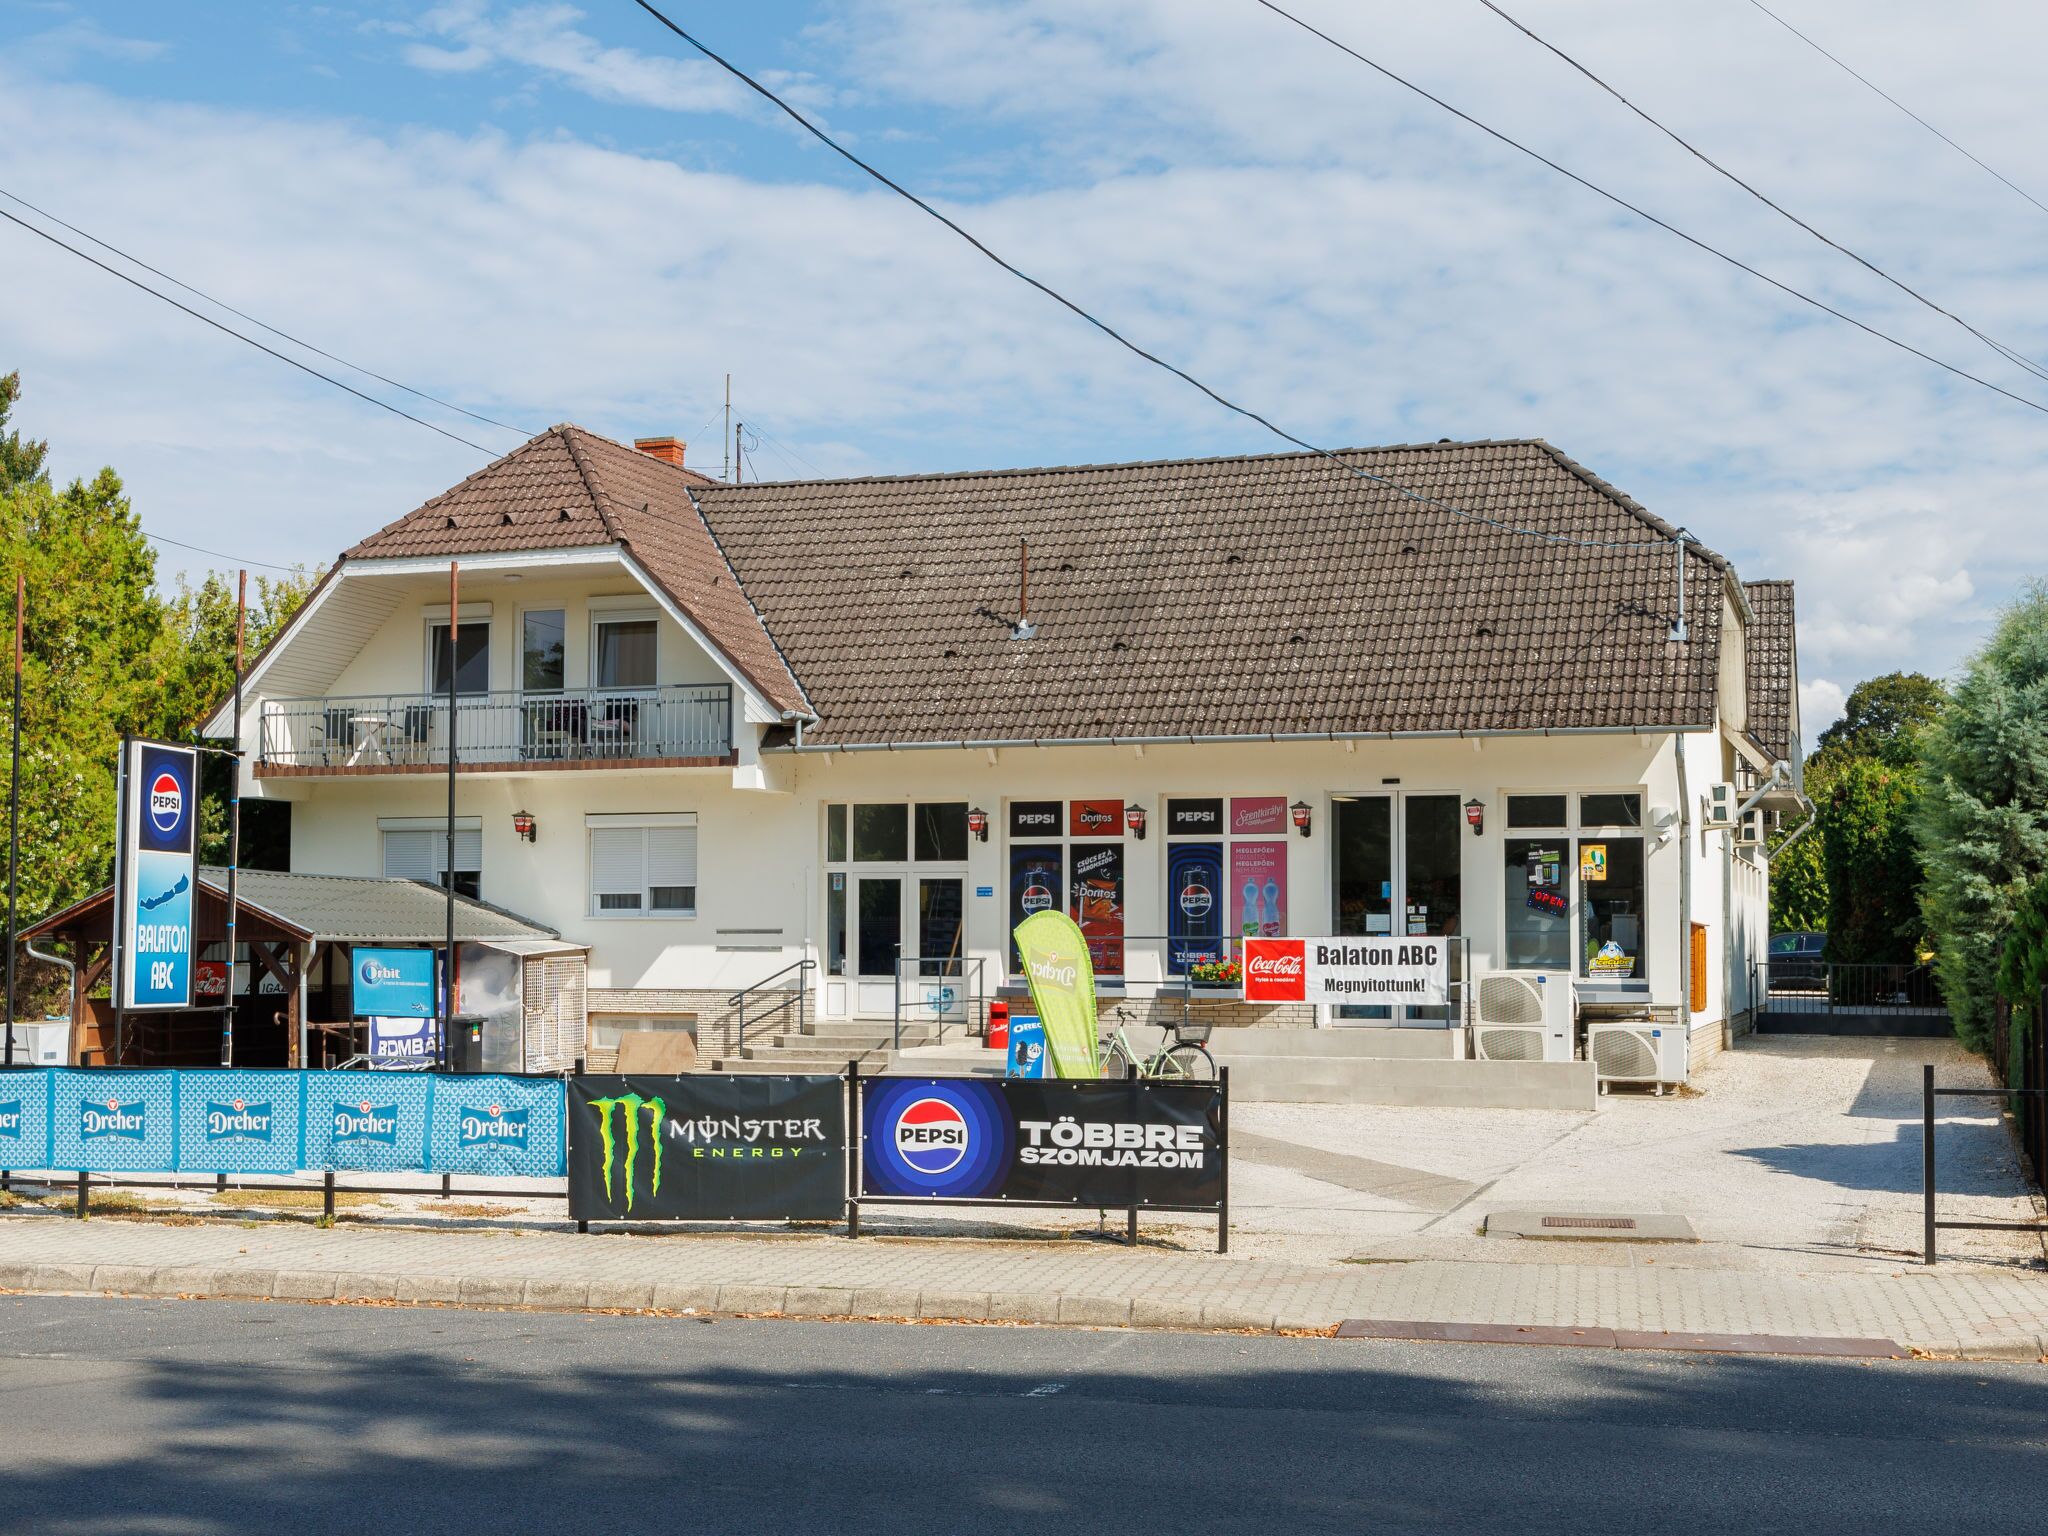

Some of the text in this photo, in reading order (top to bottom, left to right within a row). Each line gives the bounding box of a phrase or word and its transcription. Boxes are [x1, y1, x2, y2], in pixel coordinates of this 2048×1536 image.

[152, 795, 180, 810] PEPSI
[1018, 814, 1055, 825] PEPSI
[1080, 813, 1113, 823] Doritos
[1176, 811, 1215, 822] PEPSI
[1024, 897, 1051, 905] PEPSI
[1079, 888, 1117, 899] Doritos
[1182, 896, 1210, 905] PEPSI
[1535, 891, 1565, 909] OPEN
[138, 924, 188, 954] BALATON
[1248, 955, 1304, 975] Coca-Cola
[1317, 944, 1438, 966] Balaton ABC
[150, 961, 174, 990] ABC
[361, 960, 401, 985] Orbit
[1324, 978, 1426, 994] Megnyitottunk!
[82, 1109, 144, 1133] Dreher
[208, 1110, 270, 1134] Dreher
[334, 1113, 396, 1136] Dreher
[461, 1115, 527, 1140] Dreher
[669, 1115, 826, 1144] MONSTER
[900, 1127, 963, 1145] PEPSI
[1019, 1116, 1204, 1151] TÖBBRE
[693, 1147, 803, 1158] ENERGY
[1019, 1148, 1204, 1169] SZOMJAZOM
